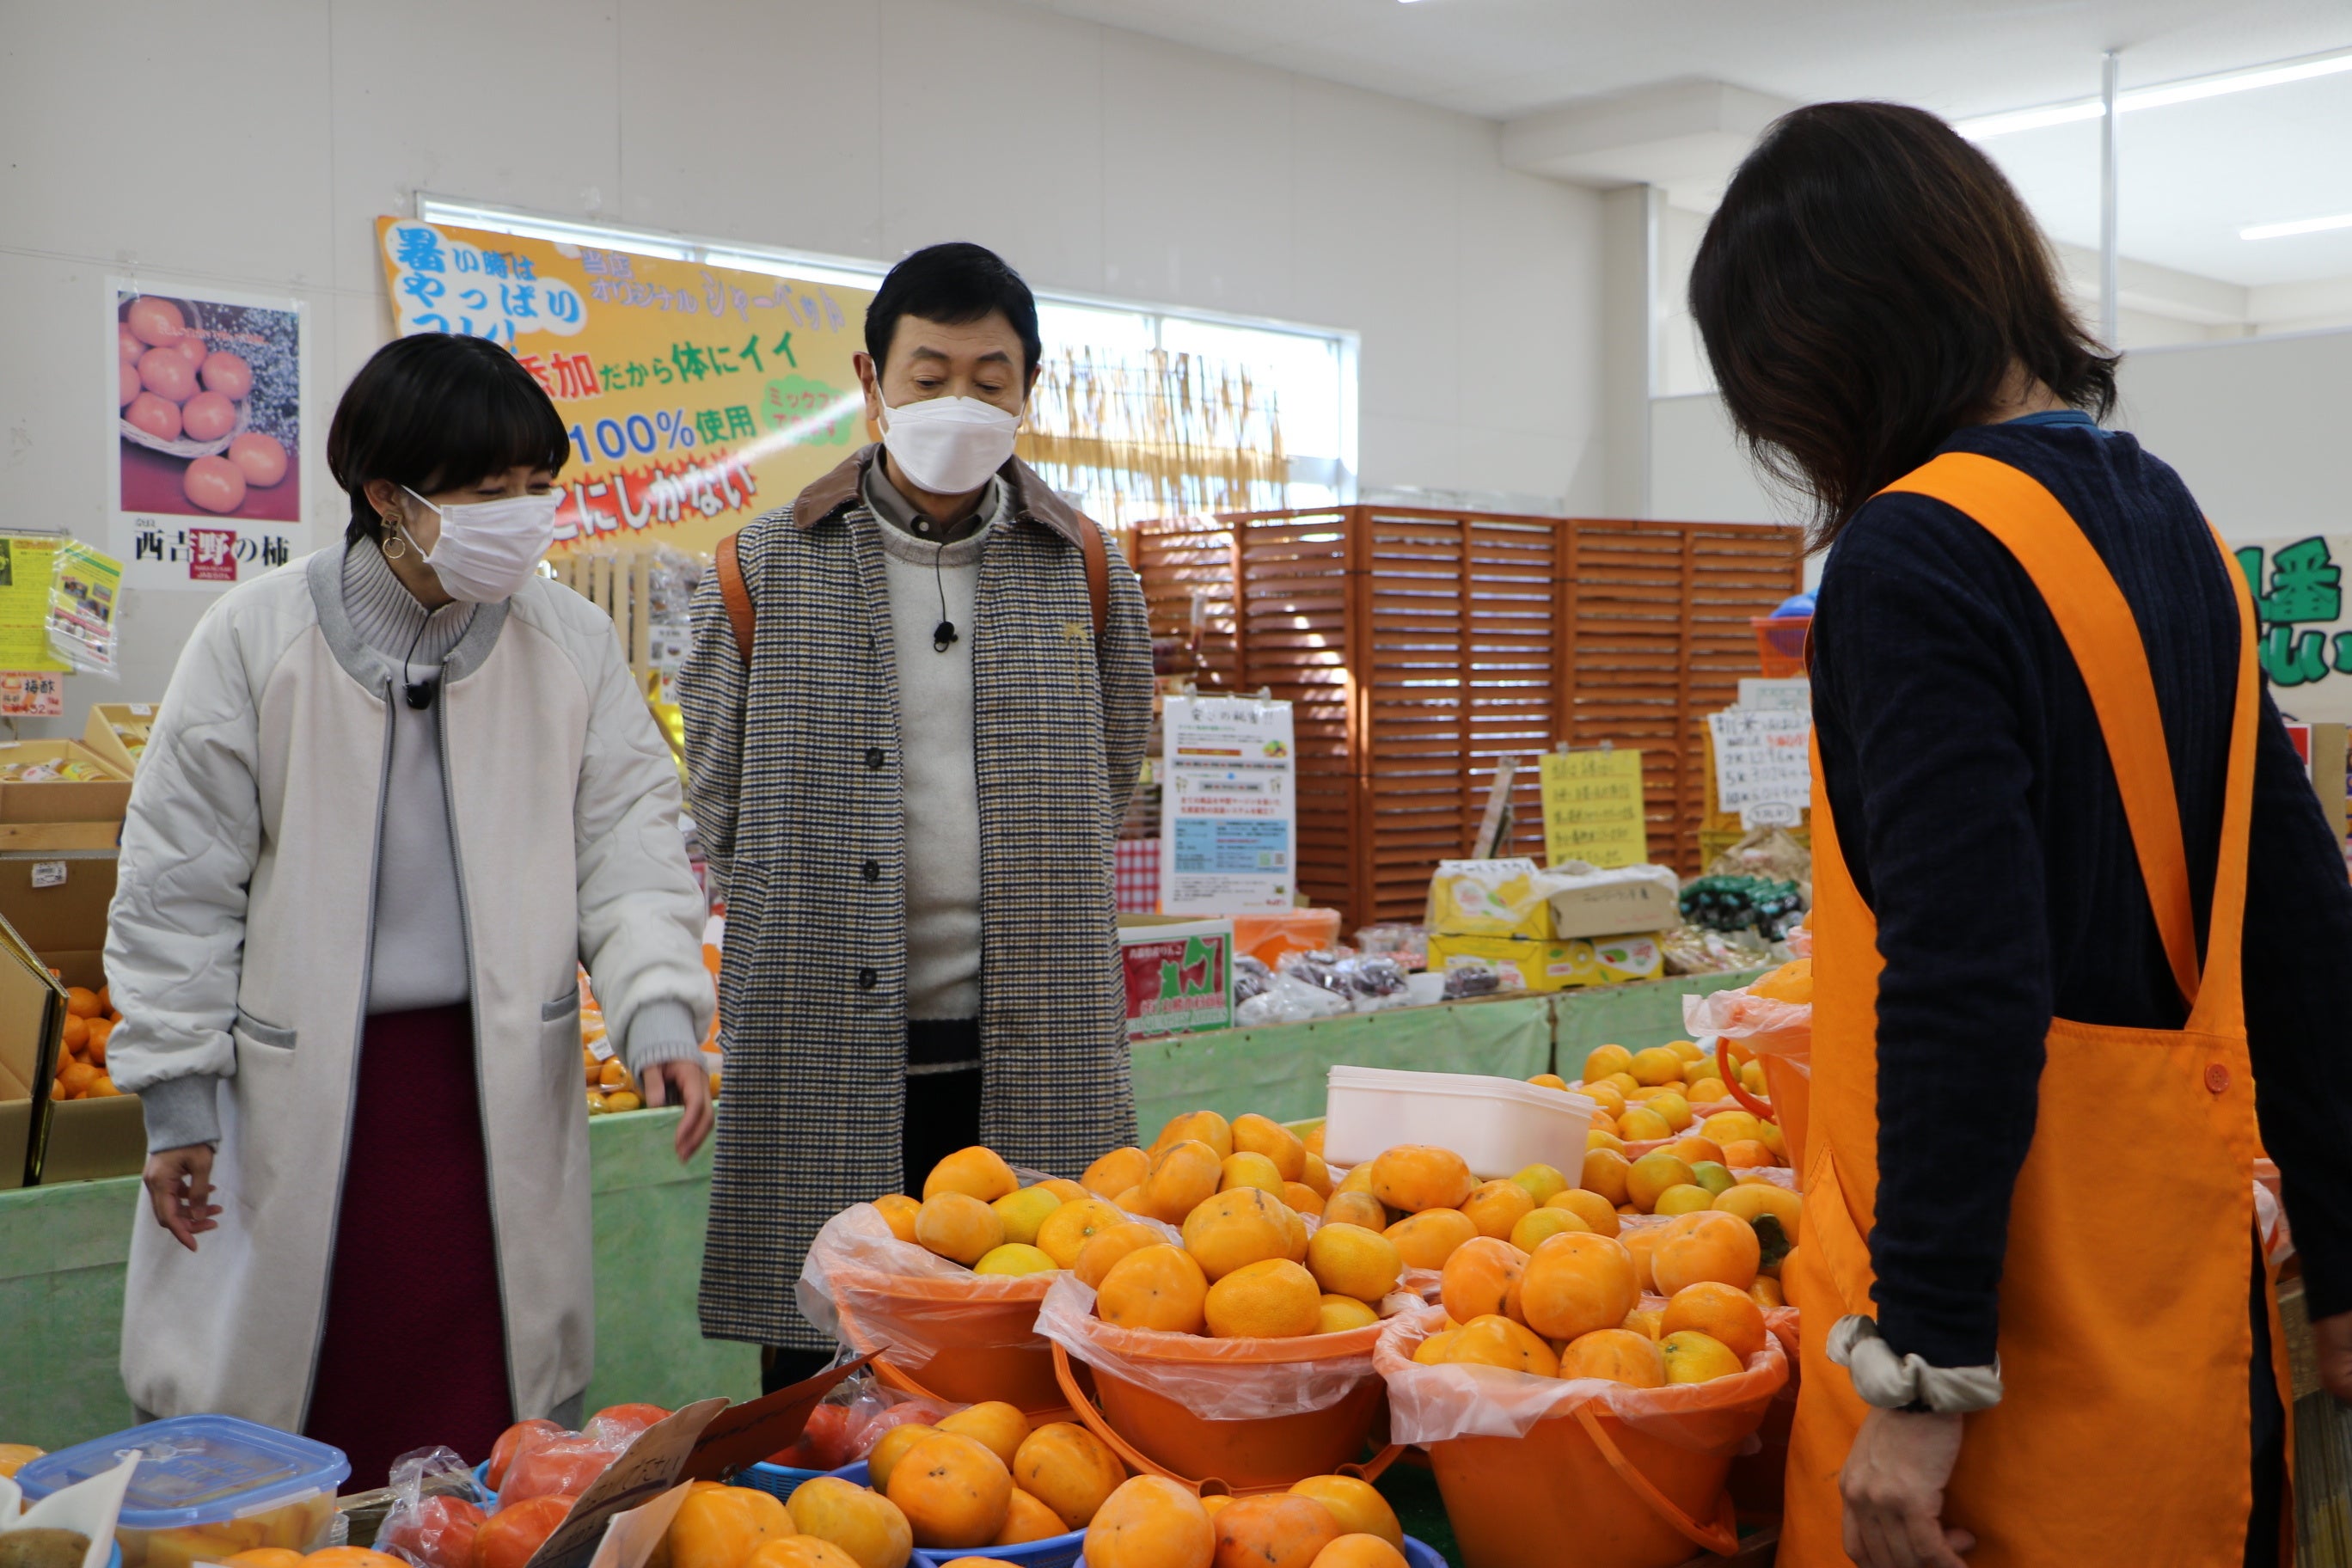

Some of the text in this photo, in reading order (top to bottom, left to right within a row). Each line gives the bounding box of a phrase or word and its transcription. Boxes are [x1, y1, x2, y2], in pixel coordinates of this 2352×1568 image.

[396, 227, 537, 281] 暑い時は
[402, 272, 581, 323] やっぱり
[135, 529, 291, 567] 西吉野の柿
